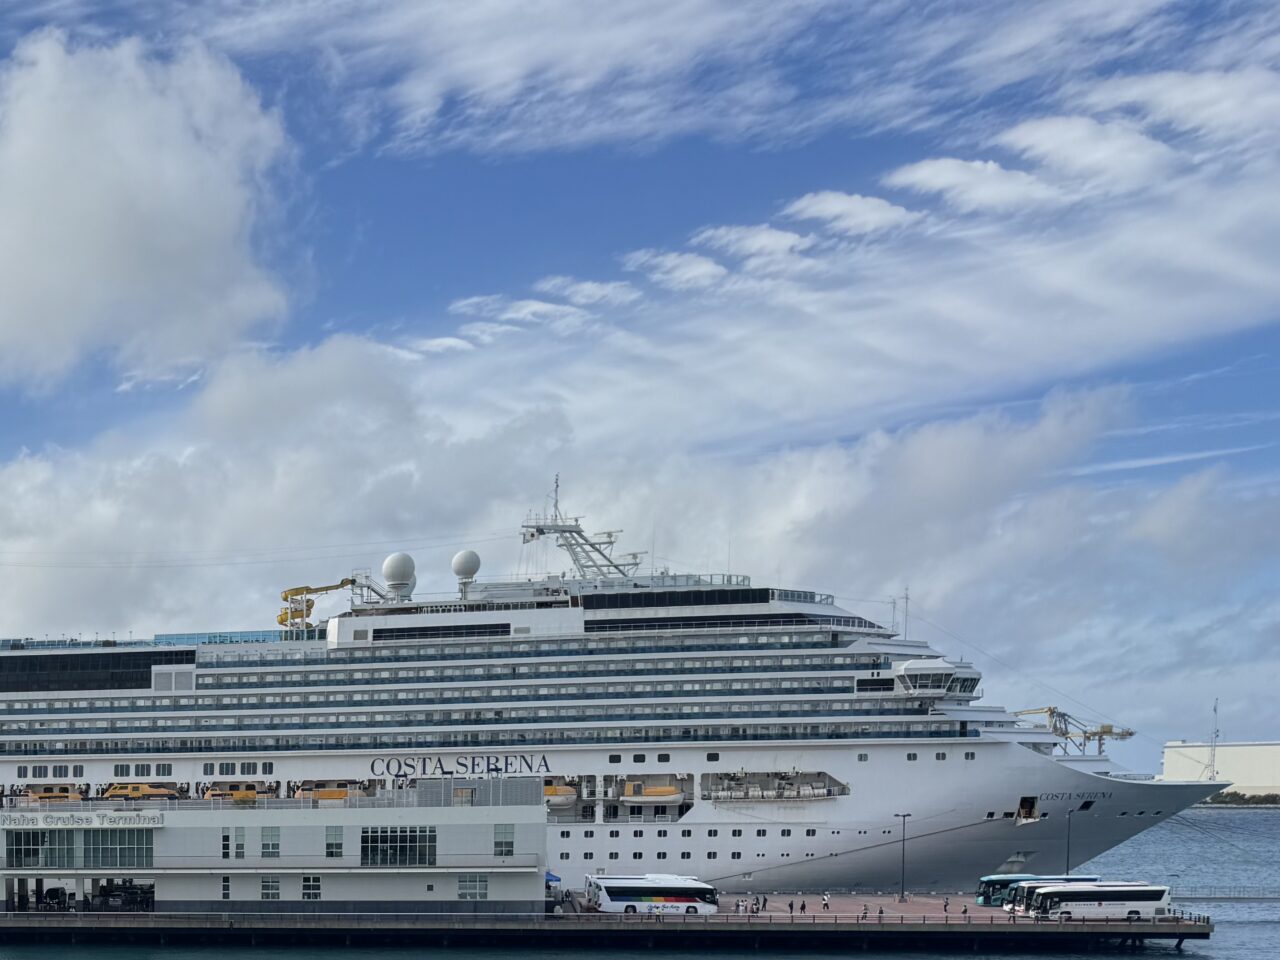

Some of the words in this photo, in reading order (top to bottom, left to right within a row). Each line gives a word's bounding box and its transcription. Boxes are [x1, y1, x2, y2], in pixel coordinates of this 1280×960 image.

[370, 756, 445, 778] COSTA
[456, 754, 552, 775] SERENA
[0, 814, 39, 827] Naha
[42, 814, 93, 826] Cruise
[96, 812, 165, 826] Terminal
